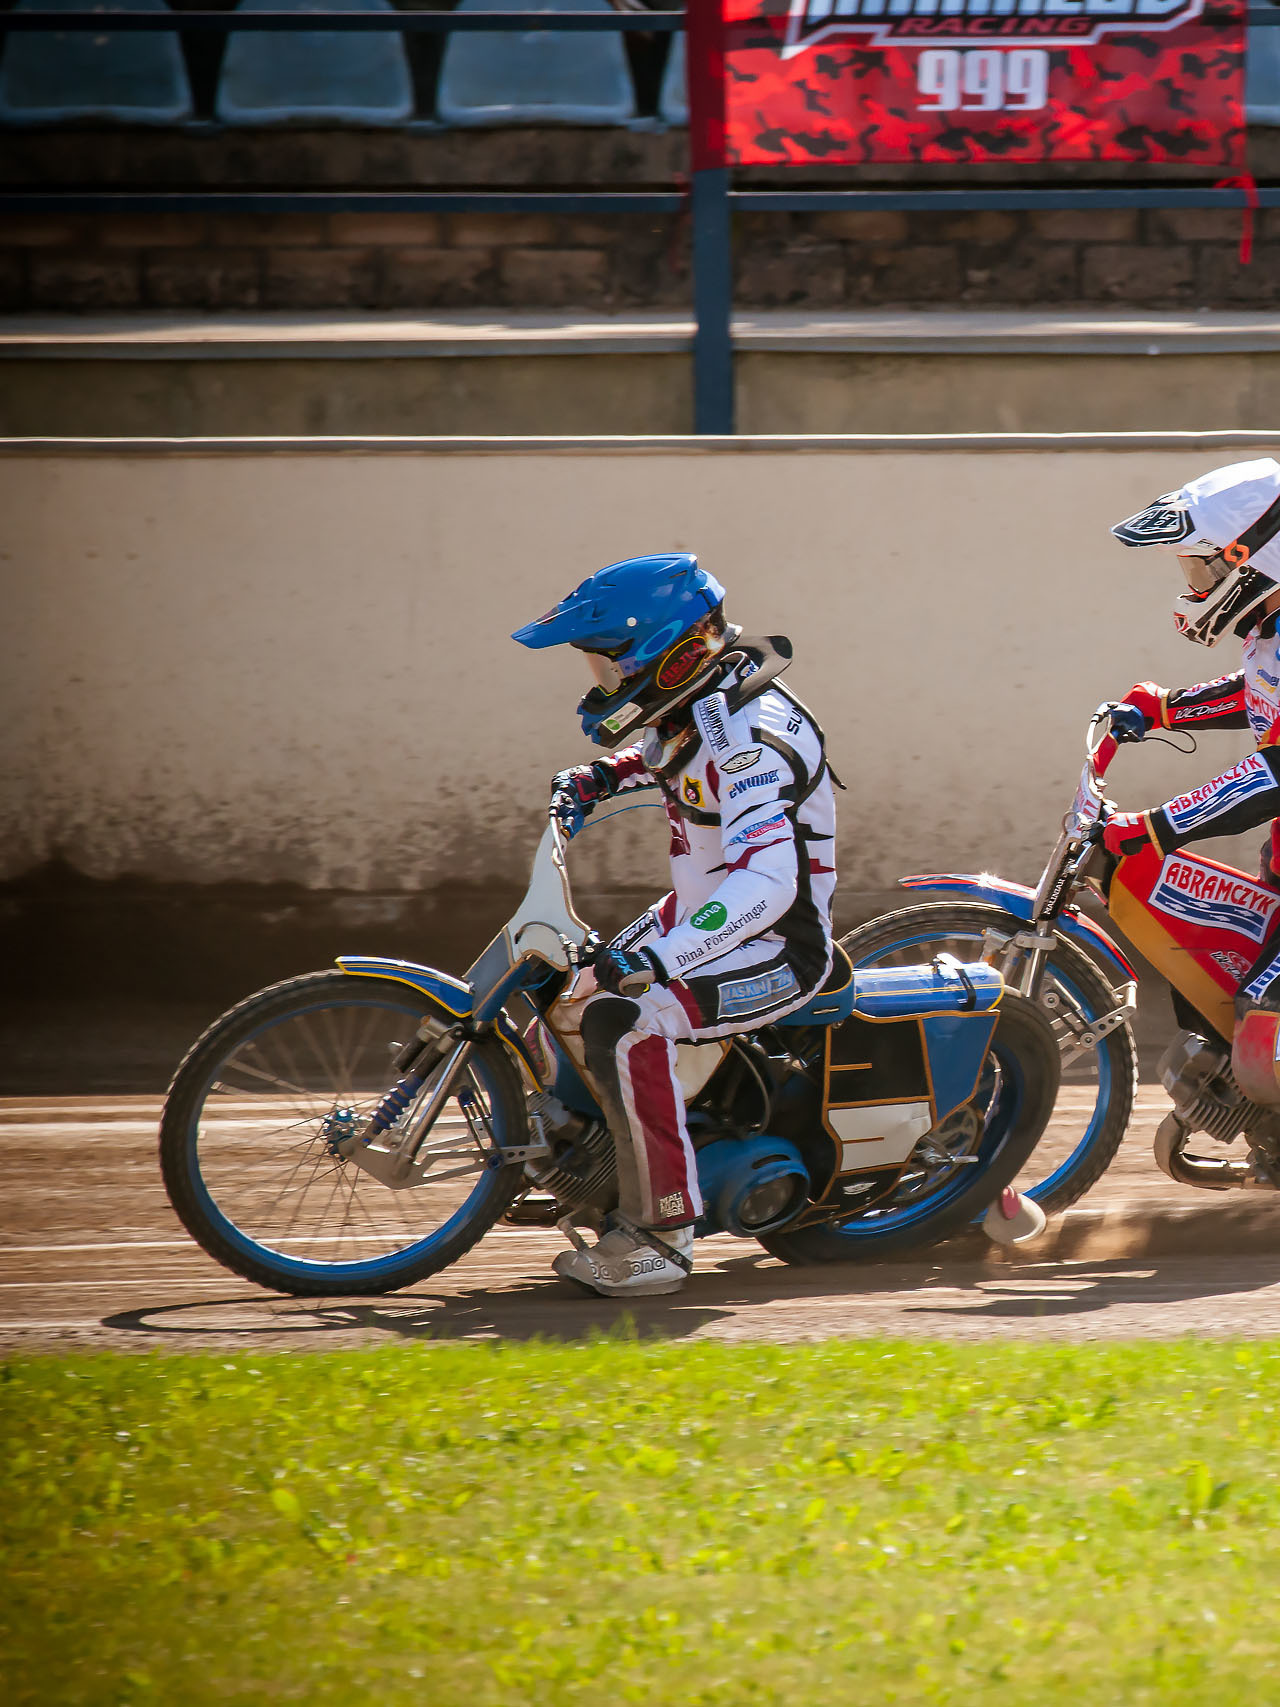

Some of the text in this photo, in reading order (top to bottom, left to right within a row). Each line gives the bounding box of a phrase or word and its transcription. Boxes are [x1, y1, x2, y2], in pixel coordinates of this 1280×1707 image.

[898, 16, 1094, 35] RACING
[916, 49, 1050, 112] 999
[1168, 756, 1264, 815] ABRAMCZYK
[694, 903, 722, 926] dina
[1164, 862, 1277, 915] ABRAMCZYK
[675, 899, 768, 968] Dina Försäkringar
